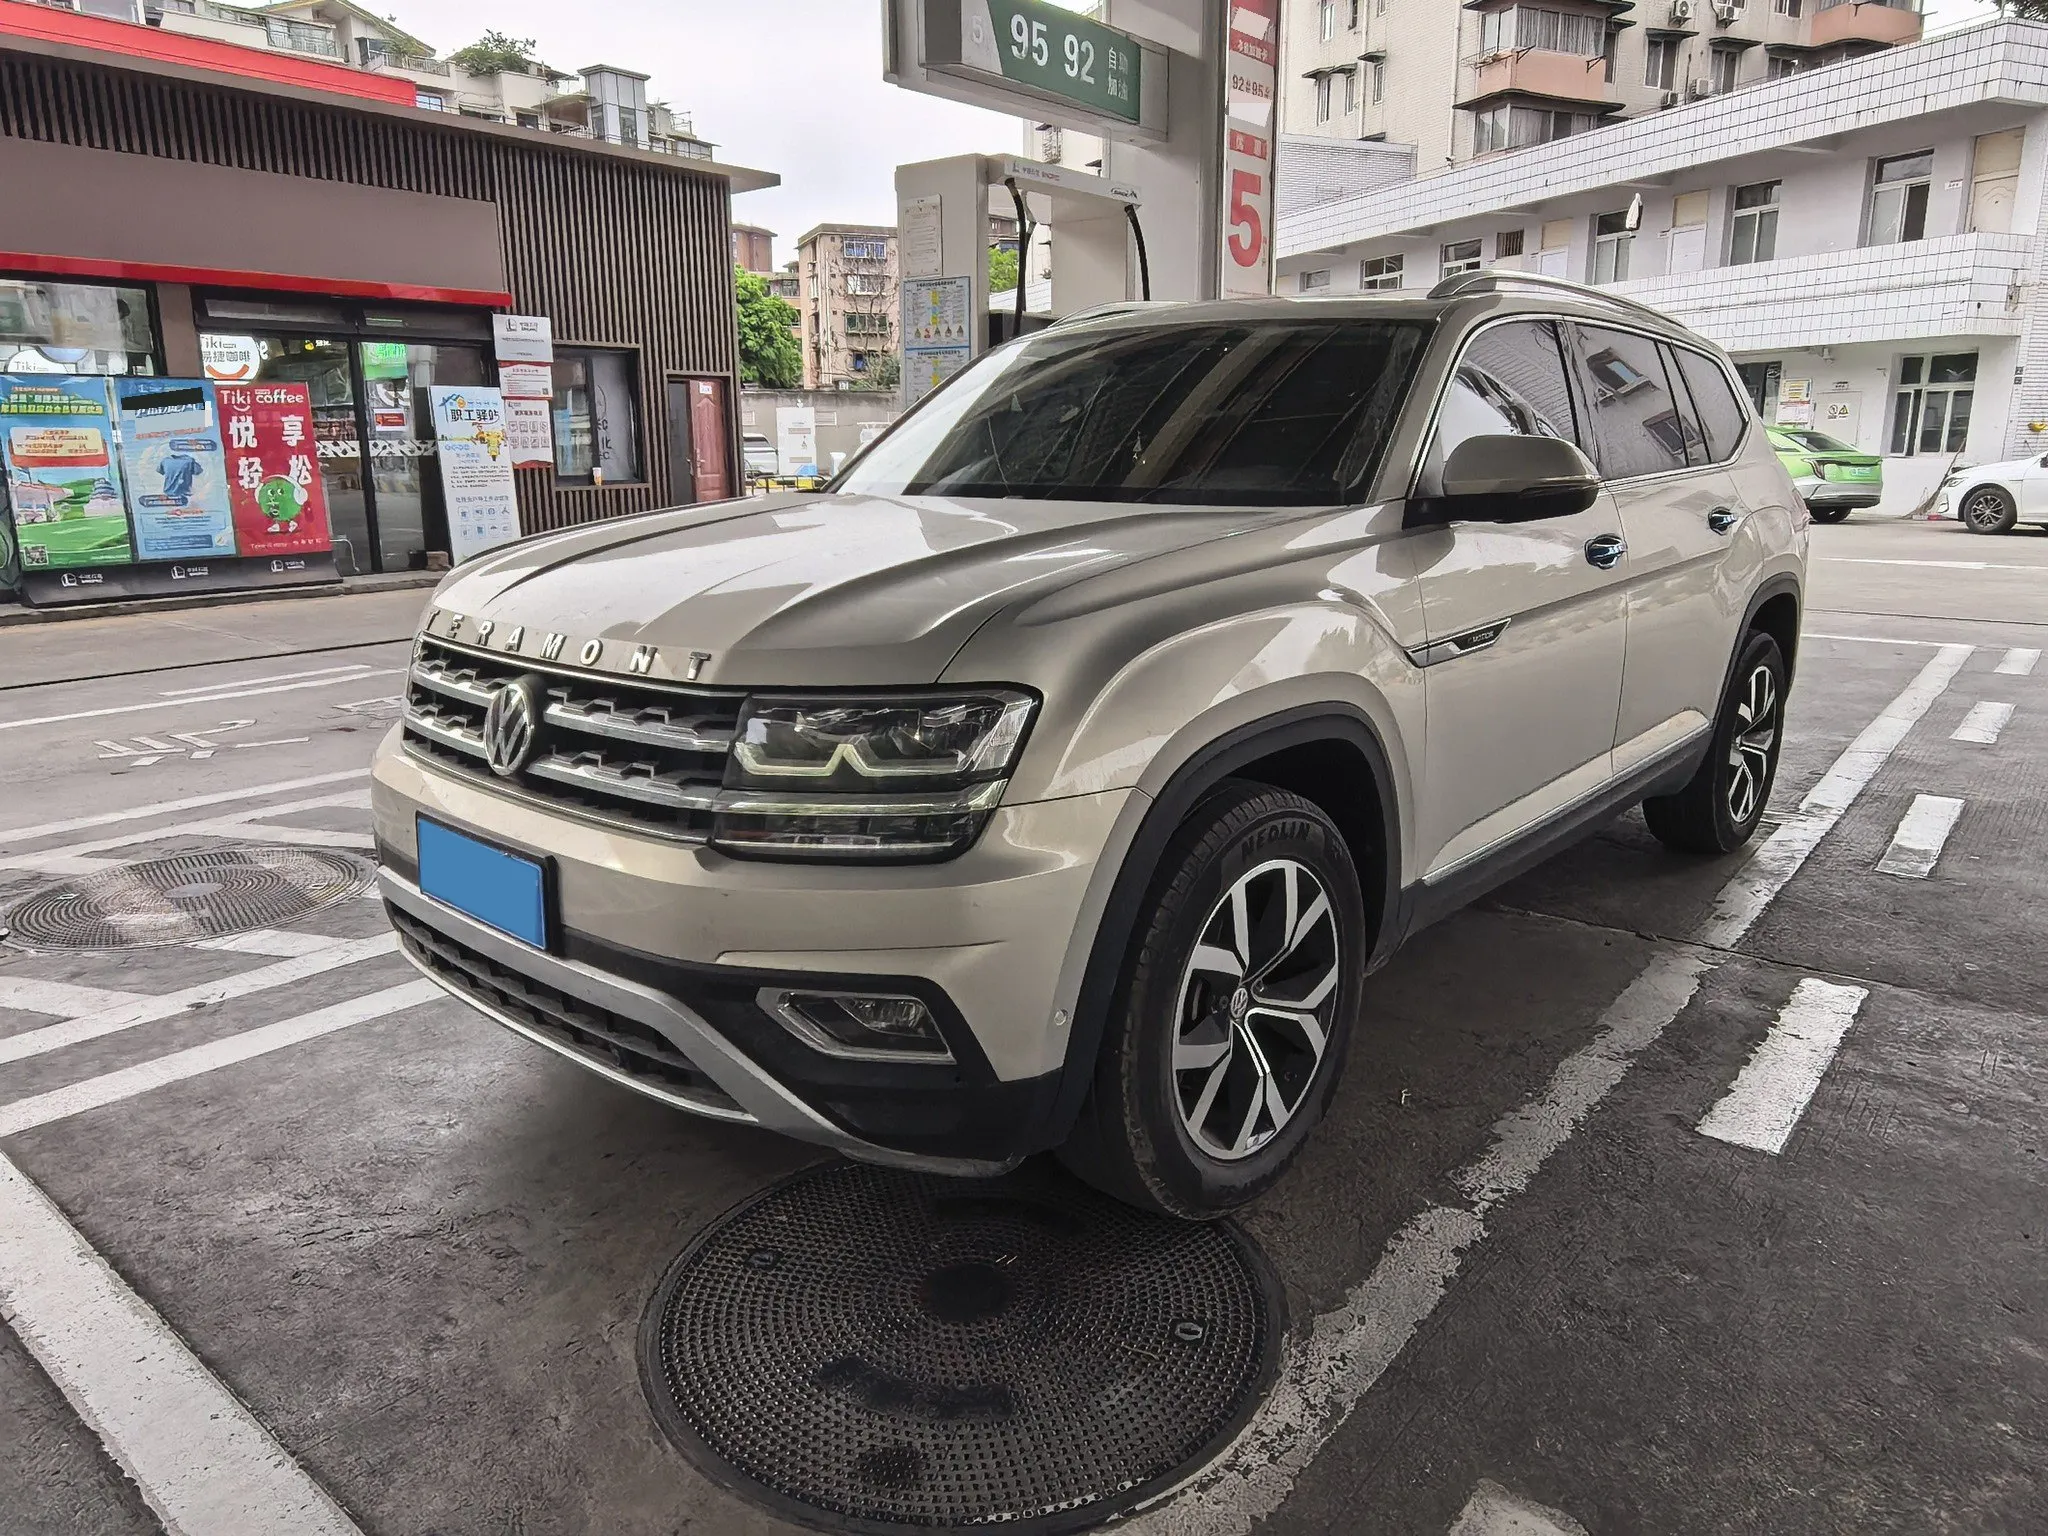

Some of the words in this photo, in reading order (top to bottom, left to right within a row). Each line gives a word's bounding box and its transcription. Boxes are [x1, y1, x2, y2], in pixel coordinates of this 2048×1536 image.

[971, 16, 984, 44] 5
[1010, 14, 1049, 67] 95
[1064, 34, 1095, 84] 92
[1228, 169, 1262, 267] 5
[220, 389, 251, 404] Tiki
[255, 389, 304, 404] coffee
[450, 409, 498, 422] 职工驿站
[425, 609, 712, 680] TERAMONT
